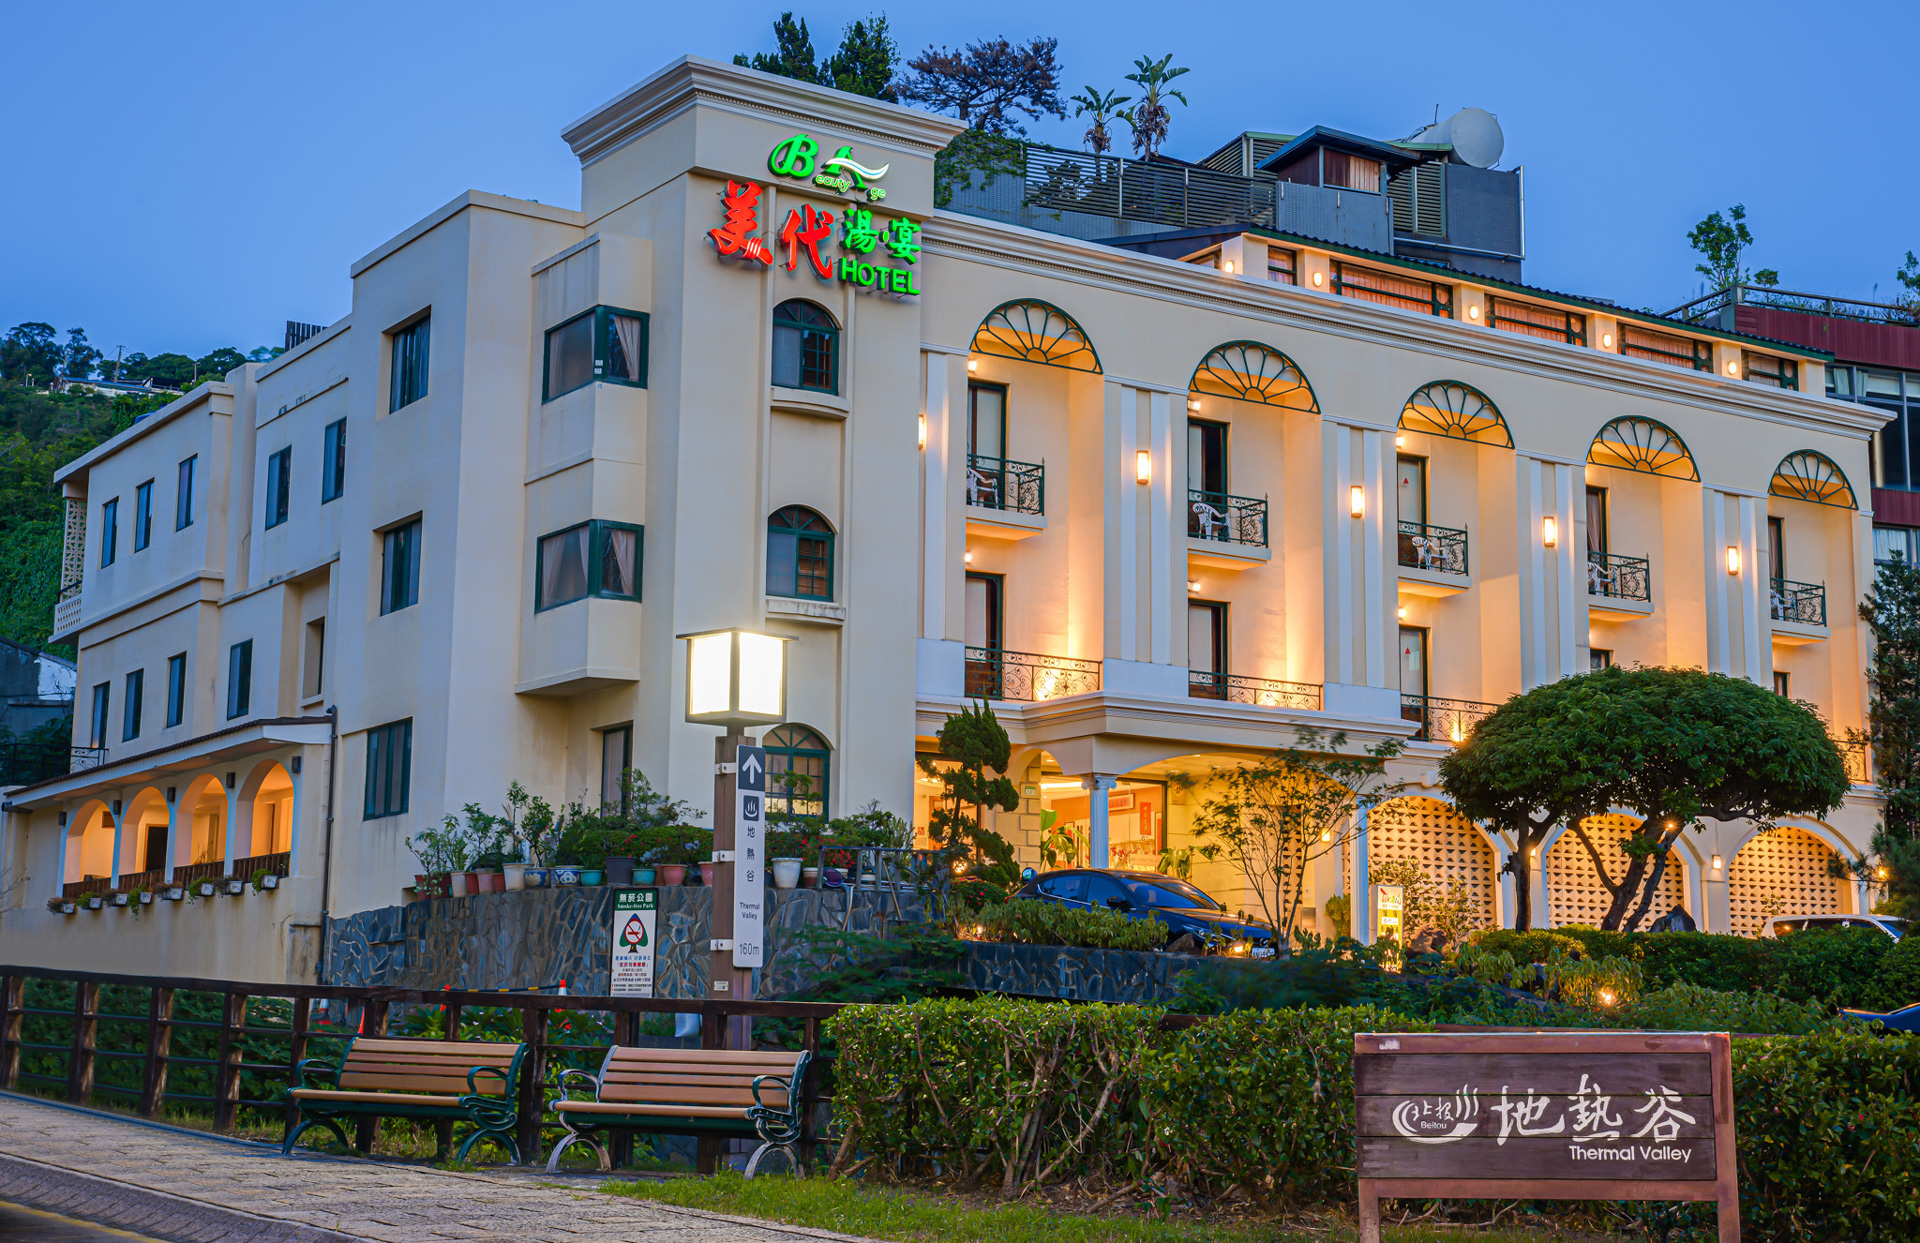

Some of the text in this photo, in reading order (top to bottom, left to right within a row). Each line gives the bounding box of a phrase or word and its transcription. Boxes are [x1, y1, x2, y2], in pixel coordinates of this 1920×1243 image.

[707, 179, 835, 279] 美代
[838, 257, 921, 296] HOTEL
[746, 825, 756, 882] 地熱谷
[739, 902, 760, 910] Thermal
[741, 911, 758, 920] Valley
[739, 942, 760, 956] 160m
[1420, 1120, 1448, 1130] Beitou
[1568, 1144, 1693, 1164] Thermal Valley
